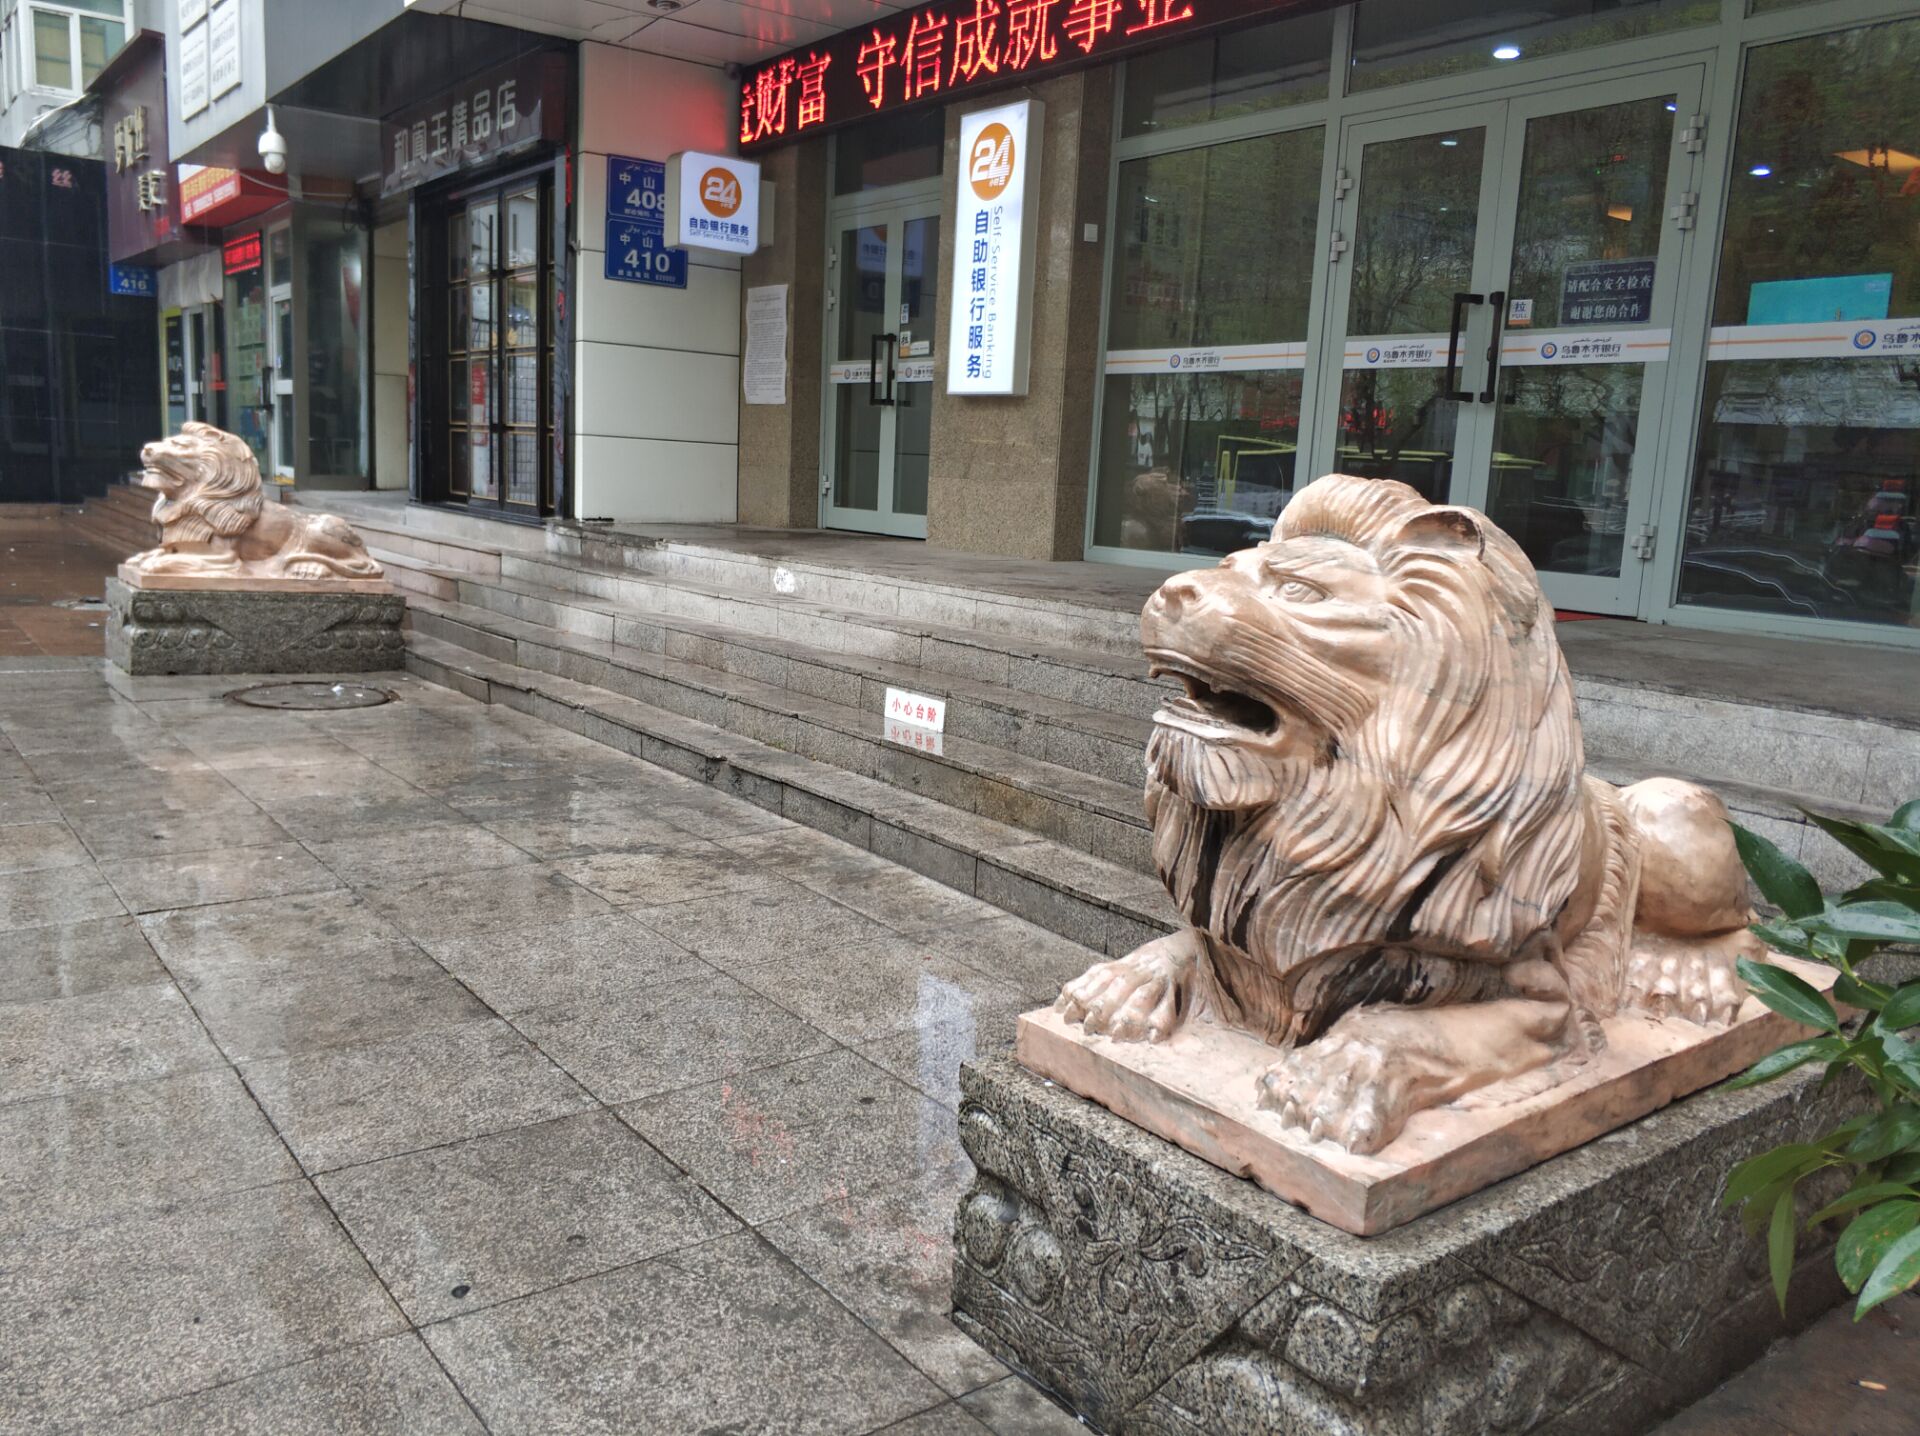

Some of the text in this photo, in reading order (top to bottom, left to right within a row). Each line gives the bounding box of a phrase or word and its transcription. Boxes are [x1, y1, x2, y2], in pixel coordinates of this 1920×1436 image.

[971, 134, 1011, 182] 24
[704, 176, 737, 205] 24
[689, 217, 750, 237] 自助银行服务
[624, 248, 670, 273] 410
[967, 209, 989, 378] 自助银行服务
[982, 206, 1003, 379] Self-Service Banking
[1567, 275, 1652, 293] 请配合安全检查
[1570, 304, 1641, 320] 谢谢您的合作
[1383, 349, 1432, 359] 乌鲁木齐银行
[1562, 344, 1621, 355] 乌鲁木齐银行
[892, 697, 937, 722] 小心台阶
